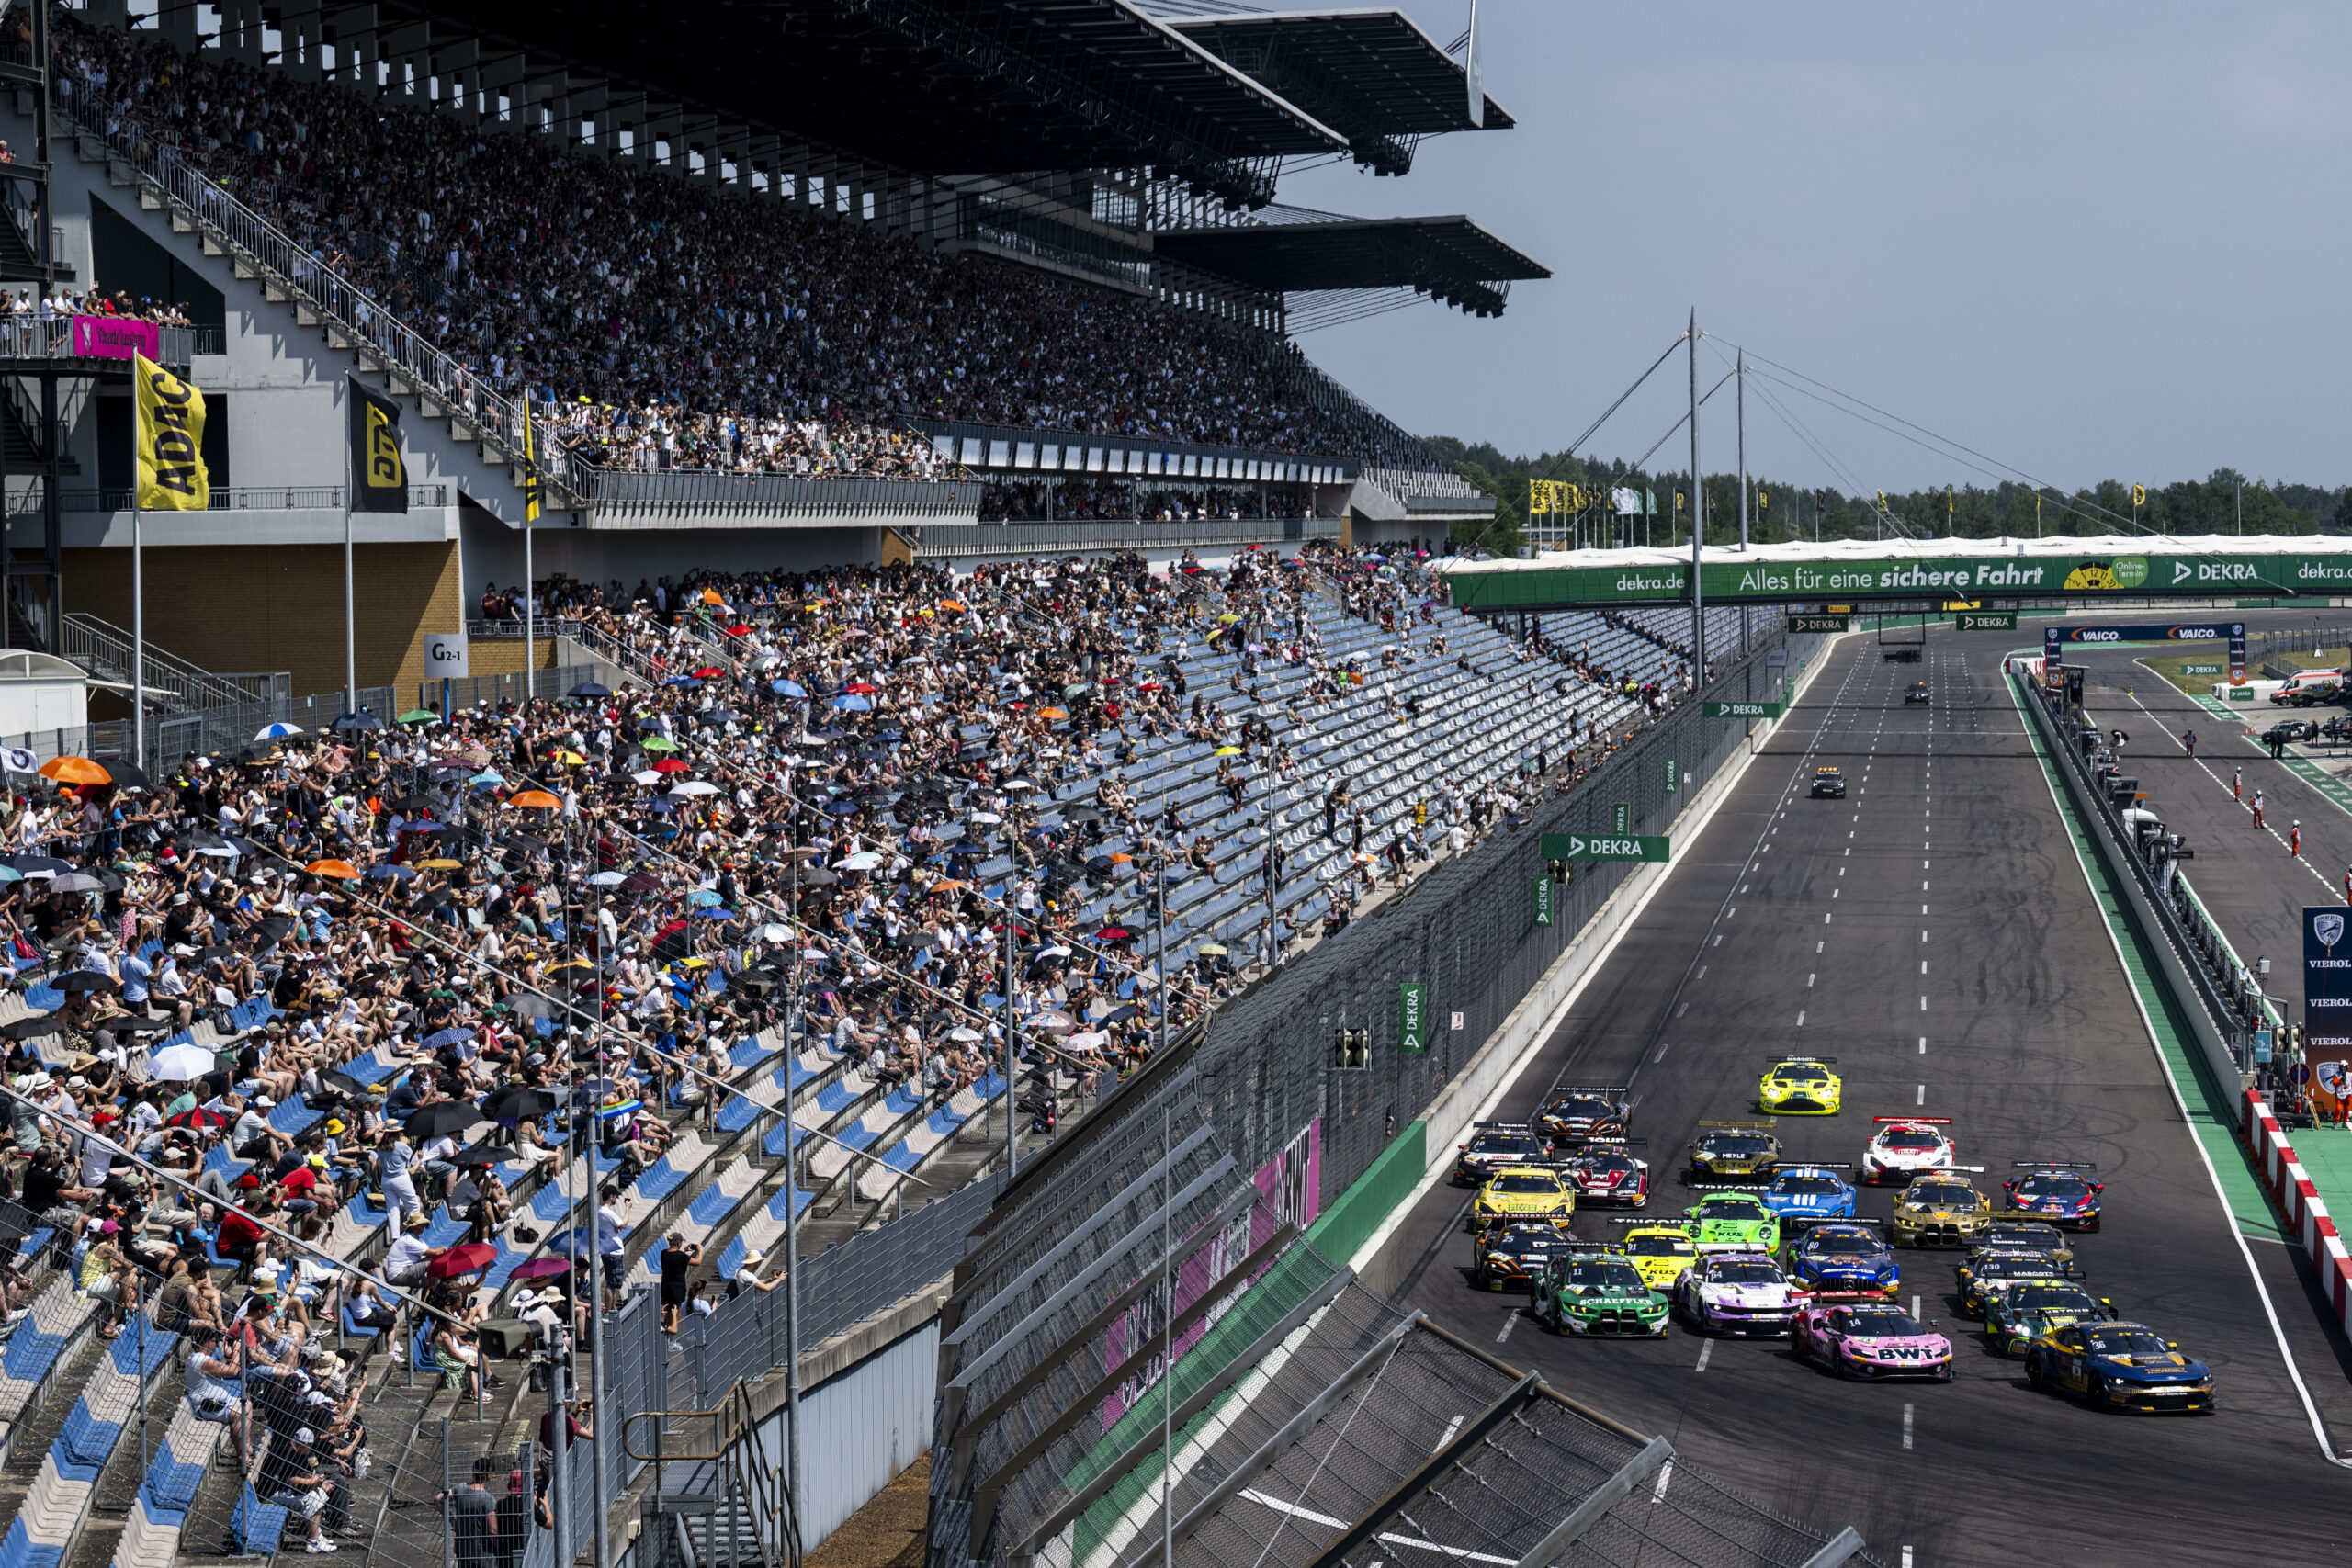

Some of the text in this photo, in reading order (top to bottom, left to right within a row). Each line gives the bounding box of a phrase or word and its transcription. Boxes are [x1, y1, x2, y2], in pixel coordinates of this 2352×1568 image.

[151, 373, 195, 496] ADAC
[2116, 561, 2145, 570] Online-
[1739, 563, 2044, 591] Alles für eine sichere Fahrt
[2090, 570, 2098, 578] 12
[2118, 570, 2143, 578] Termin
[2199, 564, 2257, 580] DEKRA
[1617, 573, 1685, 592] dekra.de
[2107, 579, 2117, 588] 10
[1810, 620, 1841, 630] DEKRA
[1977, 617, 2009, 627] DEKRA
[2083, 631, 2120, 641] VAICO
[2179, 628, 2215, 639] VAICO
[2195, 666, 2217, 674] DEKRA
[1733, 705, 1764, 715] DEKRA
[1617, 807, 1625, 831] DEKRA
[1590, 840, 1643, 855] DEKRA
[1539, 878, 1548, 910] DEKRA
[2309, 959, 2352, 968] VIEROL
[2310, 998, 2352, 1007] VIEROL
[1407, 988, 1419, 1030] DEKRA
[2310, 1037, 2352, 1045] VIEROL
[1284, 1124, 1311, 1231] BWT
[1808, 1241, 1819, 1249] 80
[1572, 1268, 1583, 1276] 11
[1712, 1270, 1723, 1279] 64
[1579, 1298, 1654, 1306] SCHAEFFLER
[1849, 1318, 1861, 1328] 14
[2093, 1340, 2106, 1350] 36
[1877, 1348, 1935, 1362] BWT
